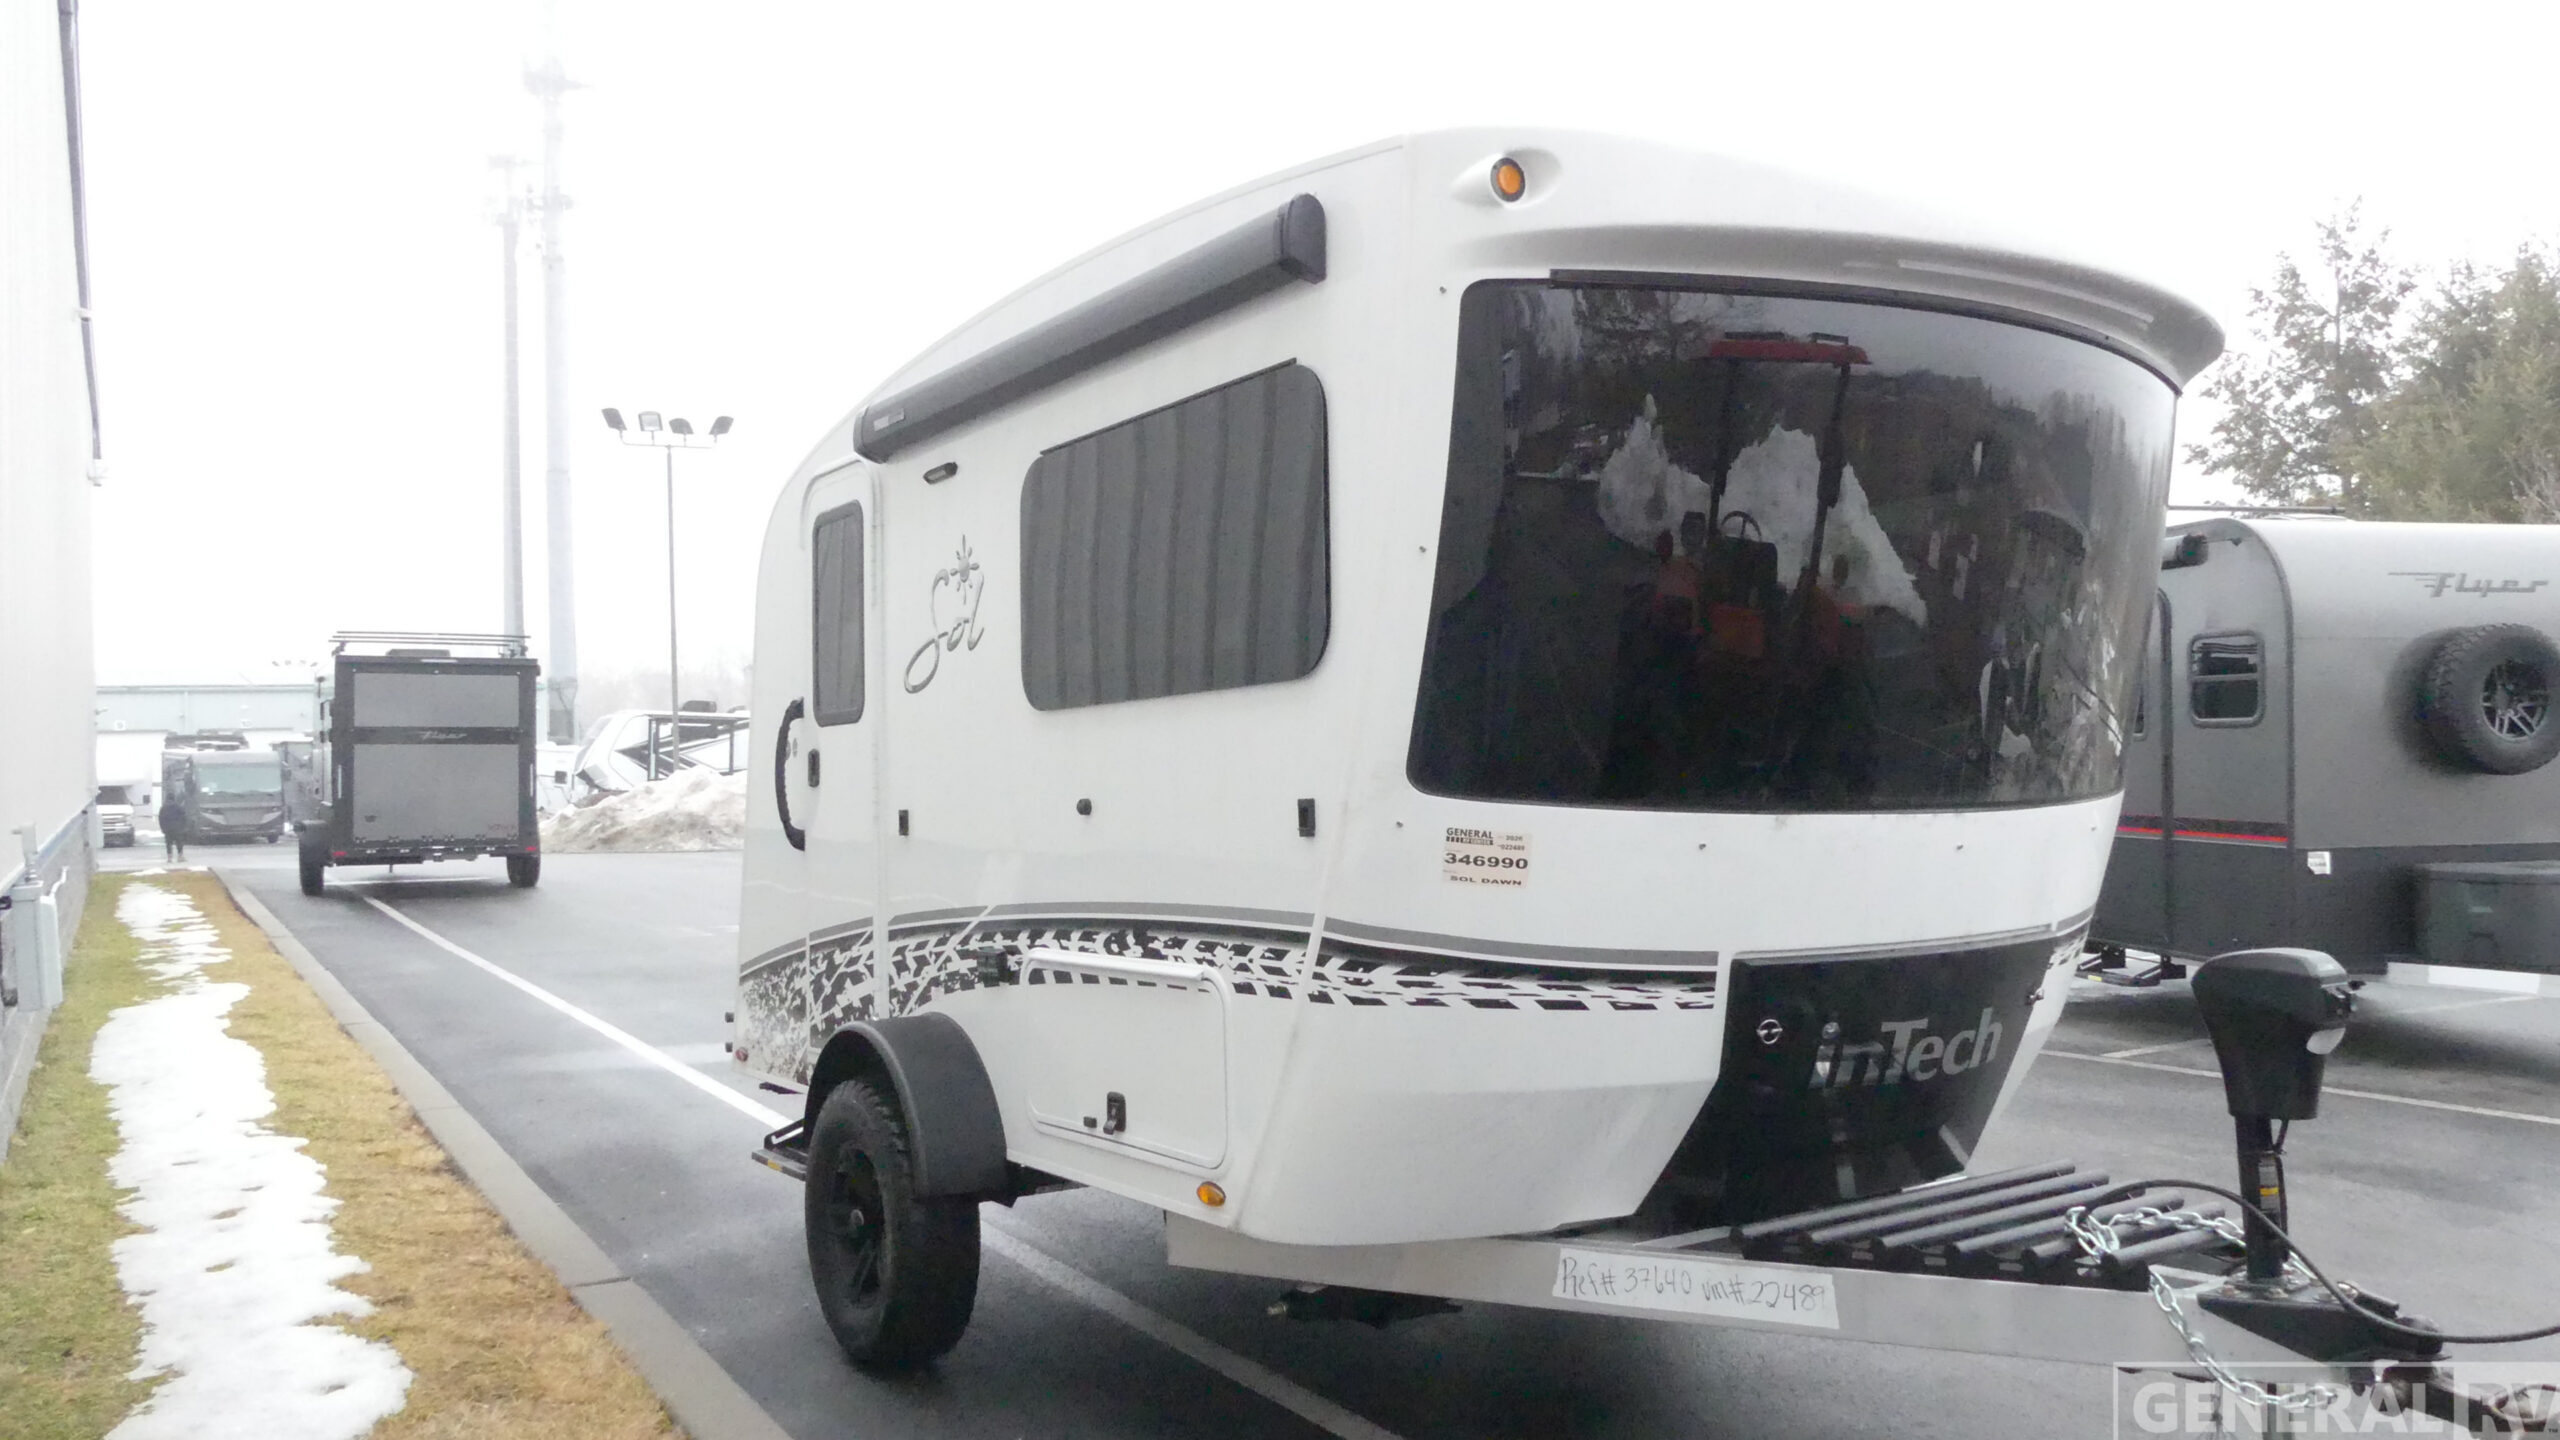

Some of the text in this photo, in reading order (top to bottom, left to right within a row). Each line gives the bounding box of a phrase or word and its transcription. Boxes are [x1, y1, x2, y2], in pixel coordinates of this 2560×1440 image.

[2388, 571, 2548, 598] Flyer
[1446, 827, 1494, 839] GENERAL
[1444, 852, 1529, 870] 346990
[1481, 878, 1522, 886] DAWN
[1808, 1006, 2004, 1089] inTech
[1623, 1266, 1693, 1295] 37640
[1750, 1280, 1826, 1312] 22489
